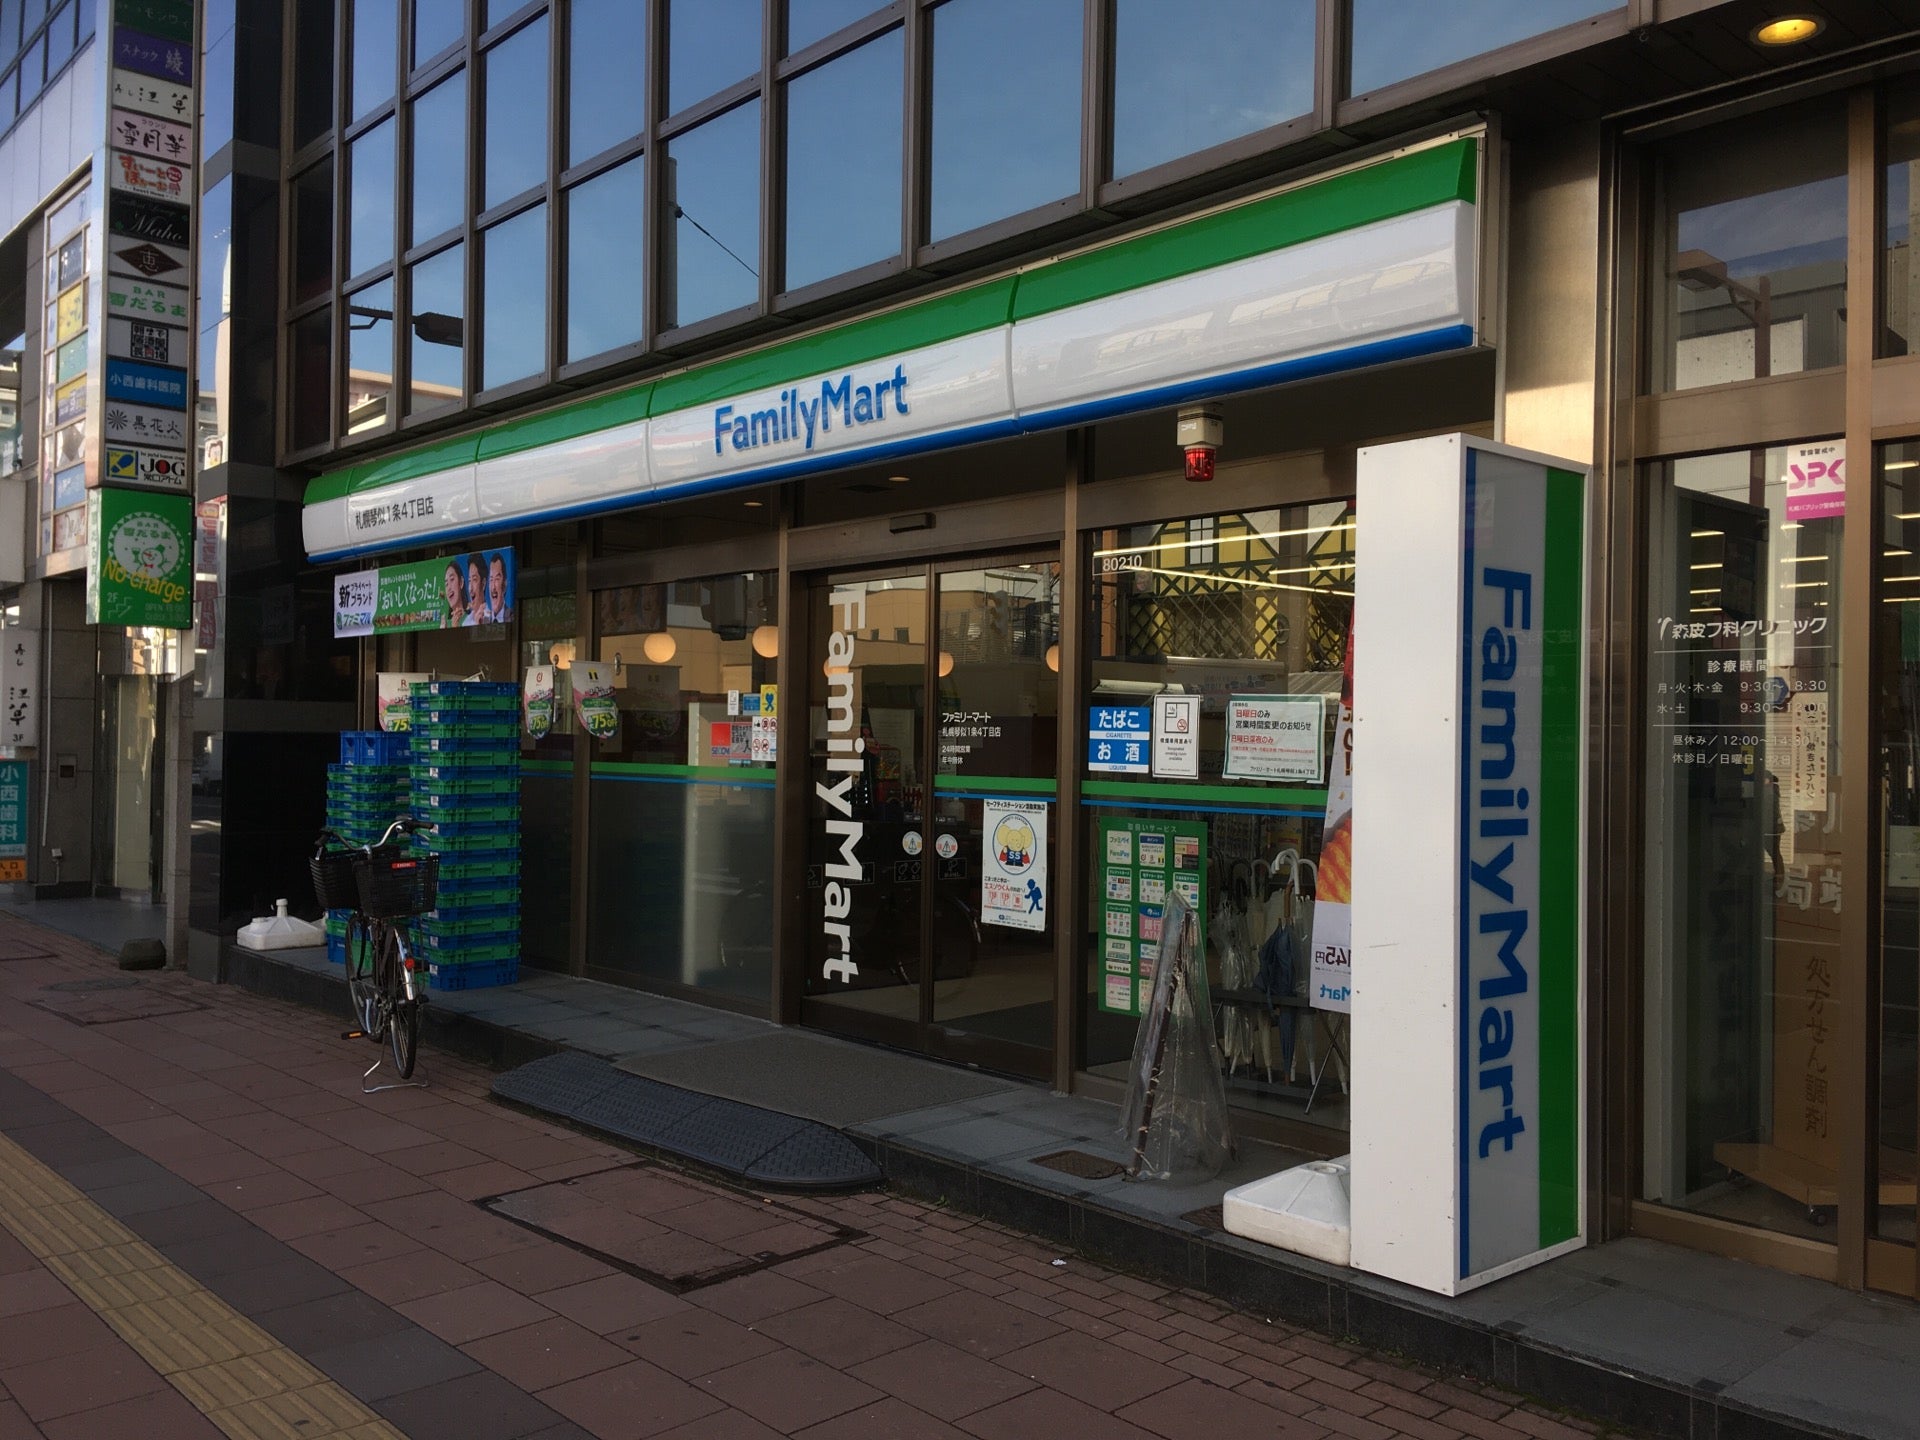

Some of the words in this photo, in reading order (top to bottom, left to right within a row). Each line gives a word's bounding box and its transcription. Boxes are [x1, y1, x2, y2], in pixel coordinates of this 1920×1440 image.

[133, 286, 166, 299] BAR
[715, 363, 908, 455] FamilyMart
[140, 459, 185, 477] JOG
[355, 496, 434, 531] 札幌琴似1条4丁目店
[1103, 555, 1143, 572] 80210
[102, 557, 127, 583] No
[130, 572, 185, 603] charge
[107, 592, 118, 602] 2F
[339, 584, 350, 608] 新
[1671, 617, 1828, 640] 森皮フ科クリニック
[1707, 659, 1770, 673] 診療時間
[942, 712, 992, 723] ファミリーマート
[1098, 710, 1140, 729] たばこ
[1235, 709, 1271, 719] 日曜日のみ
[1235, 720, 1312, 731] 営業時間変更のお知らせ
[12, 733, 24, 743] 3F
[816, 583, 867, 984] FamilyMart
[1009, 851, 1021, 860] SS
[1471, 566, 1533, 1159] FamilyMart
